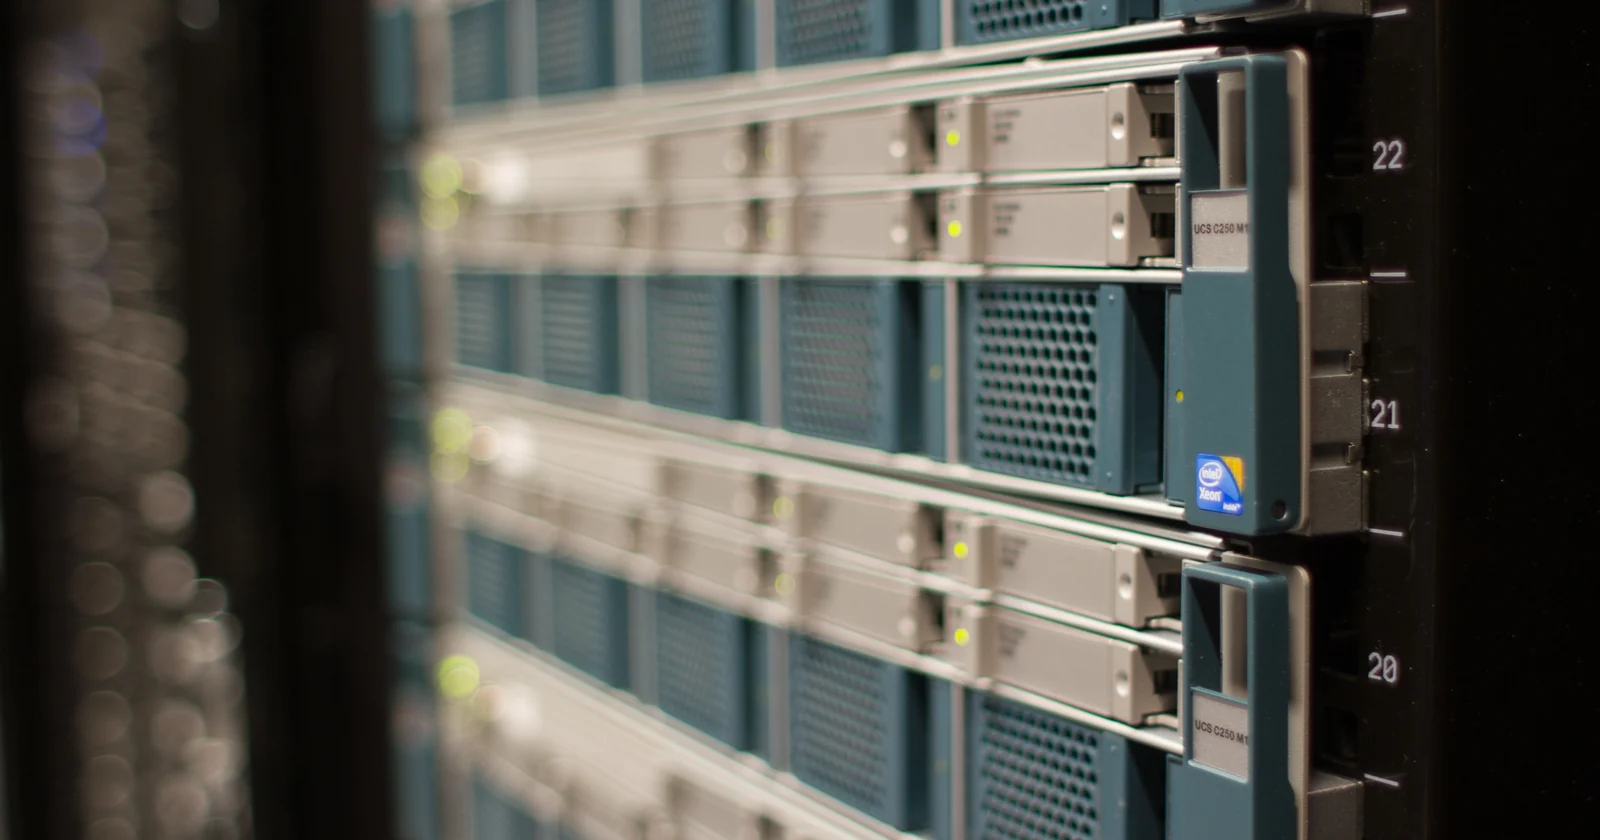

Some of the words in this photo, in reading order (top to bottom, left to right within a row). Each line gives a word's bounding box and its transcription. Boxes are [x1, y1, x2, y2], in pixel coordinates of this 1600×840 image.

[1373, 140, 1402, 170] 22
[1194, 223, 1212, 234] UCS
[1213, 223, 1235, 234] C250
[1371, 399, 1399, 429] 21
[1368, 651, 1397, 683] 20
[1194, 719, 1212, 734] UCS
[1213, 725, 1235, 741] C250
